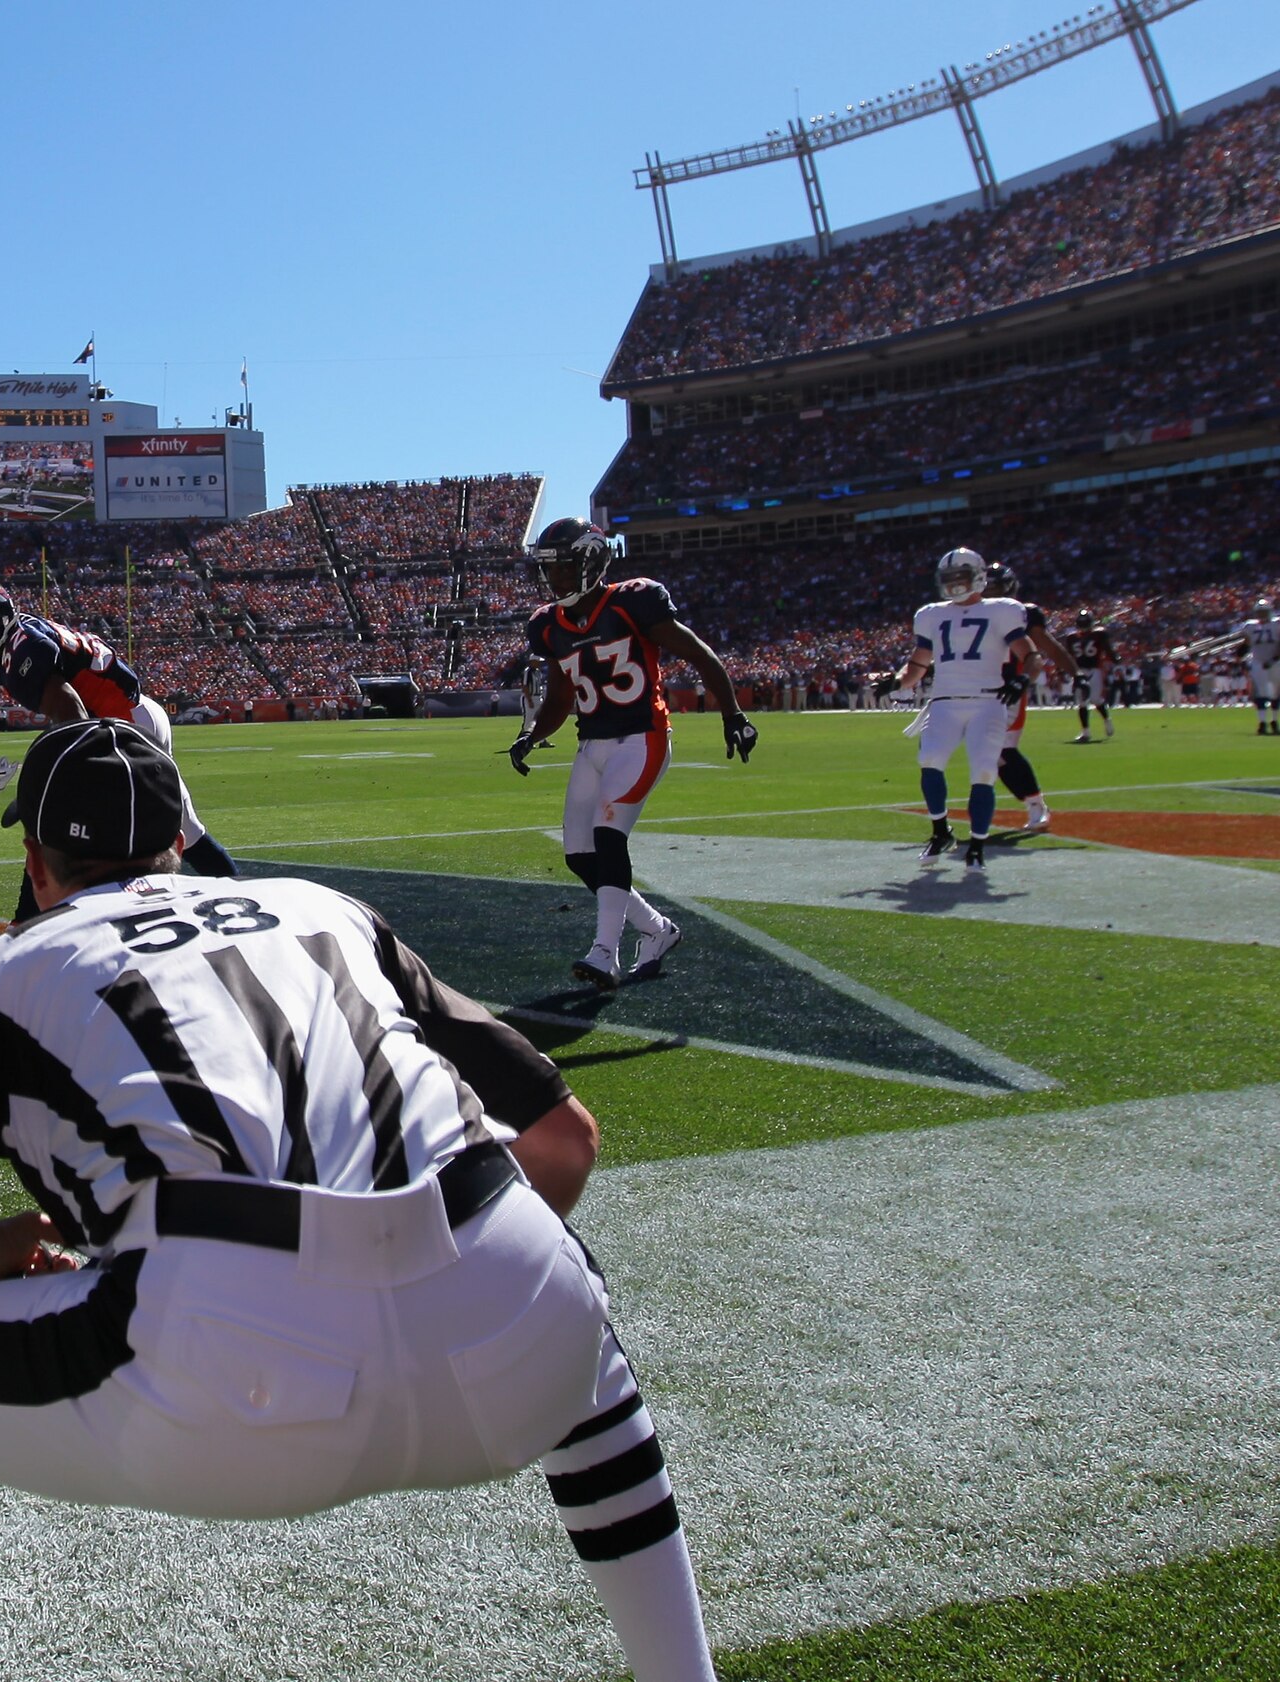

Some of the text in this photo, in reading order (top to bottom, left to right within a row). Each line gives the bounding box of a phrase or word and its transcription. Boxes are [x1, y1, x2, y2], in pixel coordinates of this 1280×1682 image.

[46, 381, 78, 399] High
[141, 438, 188, 454] xfinity
[135, 475, 218, 487] UNITED
[939, 618, 989, 663] 17
[1072, 640, 1097, 658] 56
[558, 635, 646, 714] 33
[70, 822, 91, 840] BL
[108, 896, 280, 955] 58
